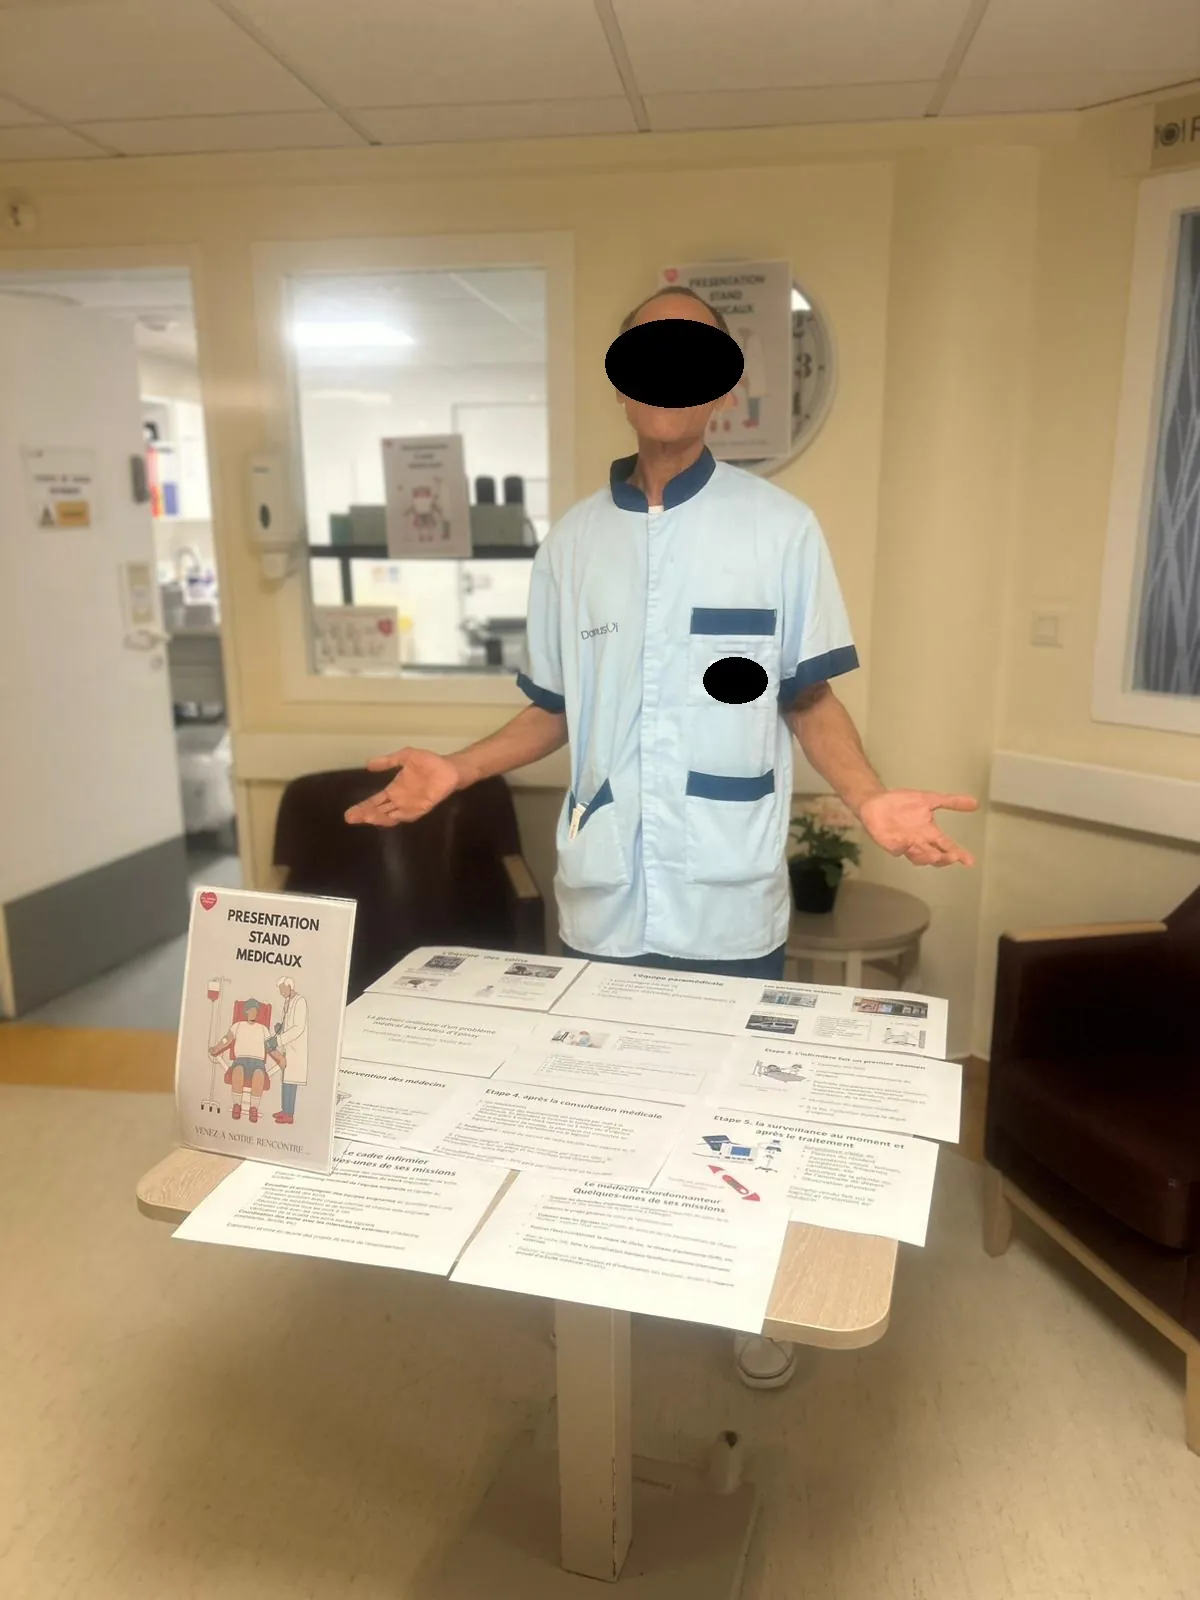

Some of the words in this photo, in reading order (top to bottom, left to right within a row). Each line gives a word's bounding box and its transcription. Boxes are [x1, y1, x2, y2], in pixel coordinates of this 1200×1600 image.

[689, 275, 765, 289] PRESENTATION
[709, 290, 743, 301] STAND
[227, 908, 320, 932] PRESENTATION
[248, 930, 291, 947] STAND
[235, 947, 303, 968] MEDICAUX
[388, 1075, 404, 1084] des
[560, 1101, 617, 1113] consultation
[228, 1132, 255, 1146] NOTRE
[256, 1138, 304, 1154] RENCONTRE
[767, 1122, 828, 1137] surveillance
[846, 1134, 892, 1147] moment
[894, 1142, 905, 1150] et
[786, 1132, 796, 1140] le
[799, 1135, 855, 1149] traitement
[356, 1150, 383, 1161] cadre
[385, 1153, 429, 1166] infirmier
[379, 1161, 392, 1170] de
[394, 1165, 410, 1173] ses
[412, 1167, 456, 1178] missions
[572, 1187, 646, 1203] Quelques-unes
[648, 1196, 661, 1205] de
[663, 1200, 679, 1208] ses
[681, 1201, 726, 1214] missions
